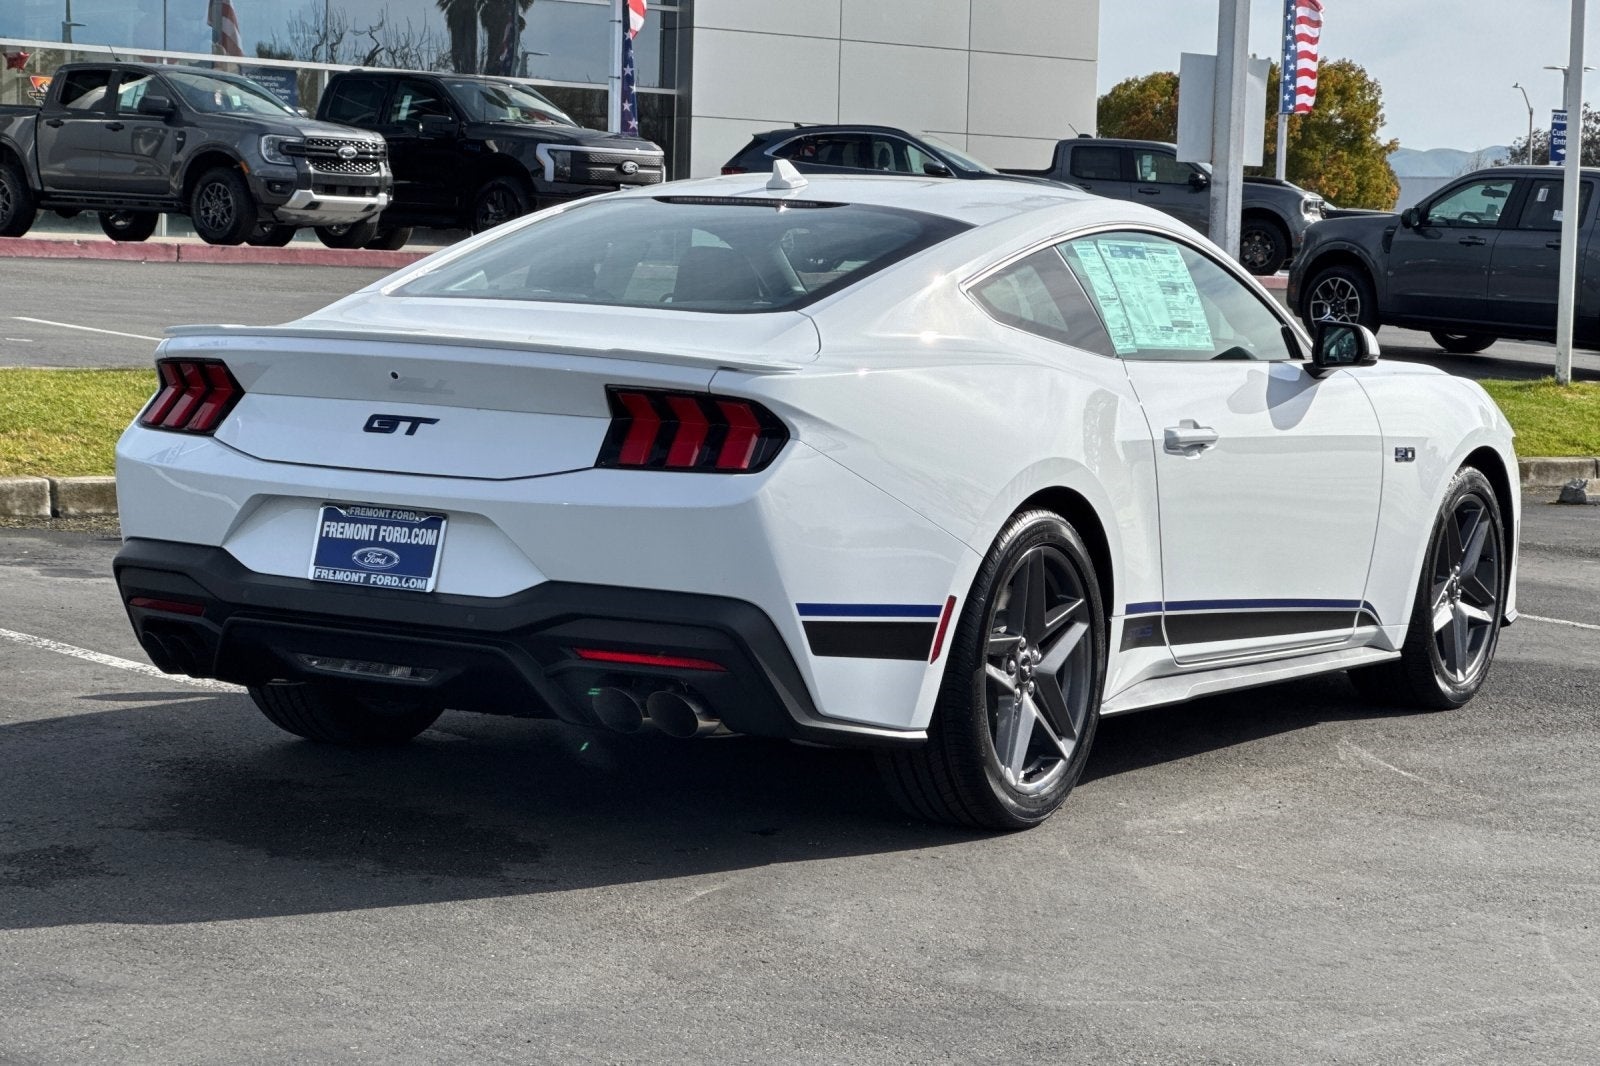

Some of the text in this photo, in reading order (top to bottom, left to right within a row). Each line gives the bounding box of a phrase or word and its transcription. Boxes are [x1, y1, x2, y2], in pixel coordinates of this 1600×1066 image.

[363, 413, 441, 436] GT
[349, 506, 416, 521] FREMONT FORD
[322, 521, 438, 546] FREMONT FORD.COM
[363, 551, 387, 565] Ford
[314, 568, 427, 590] FREMONT FORD.COM
